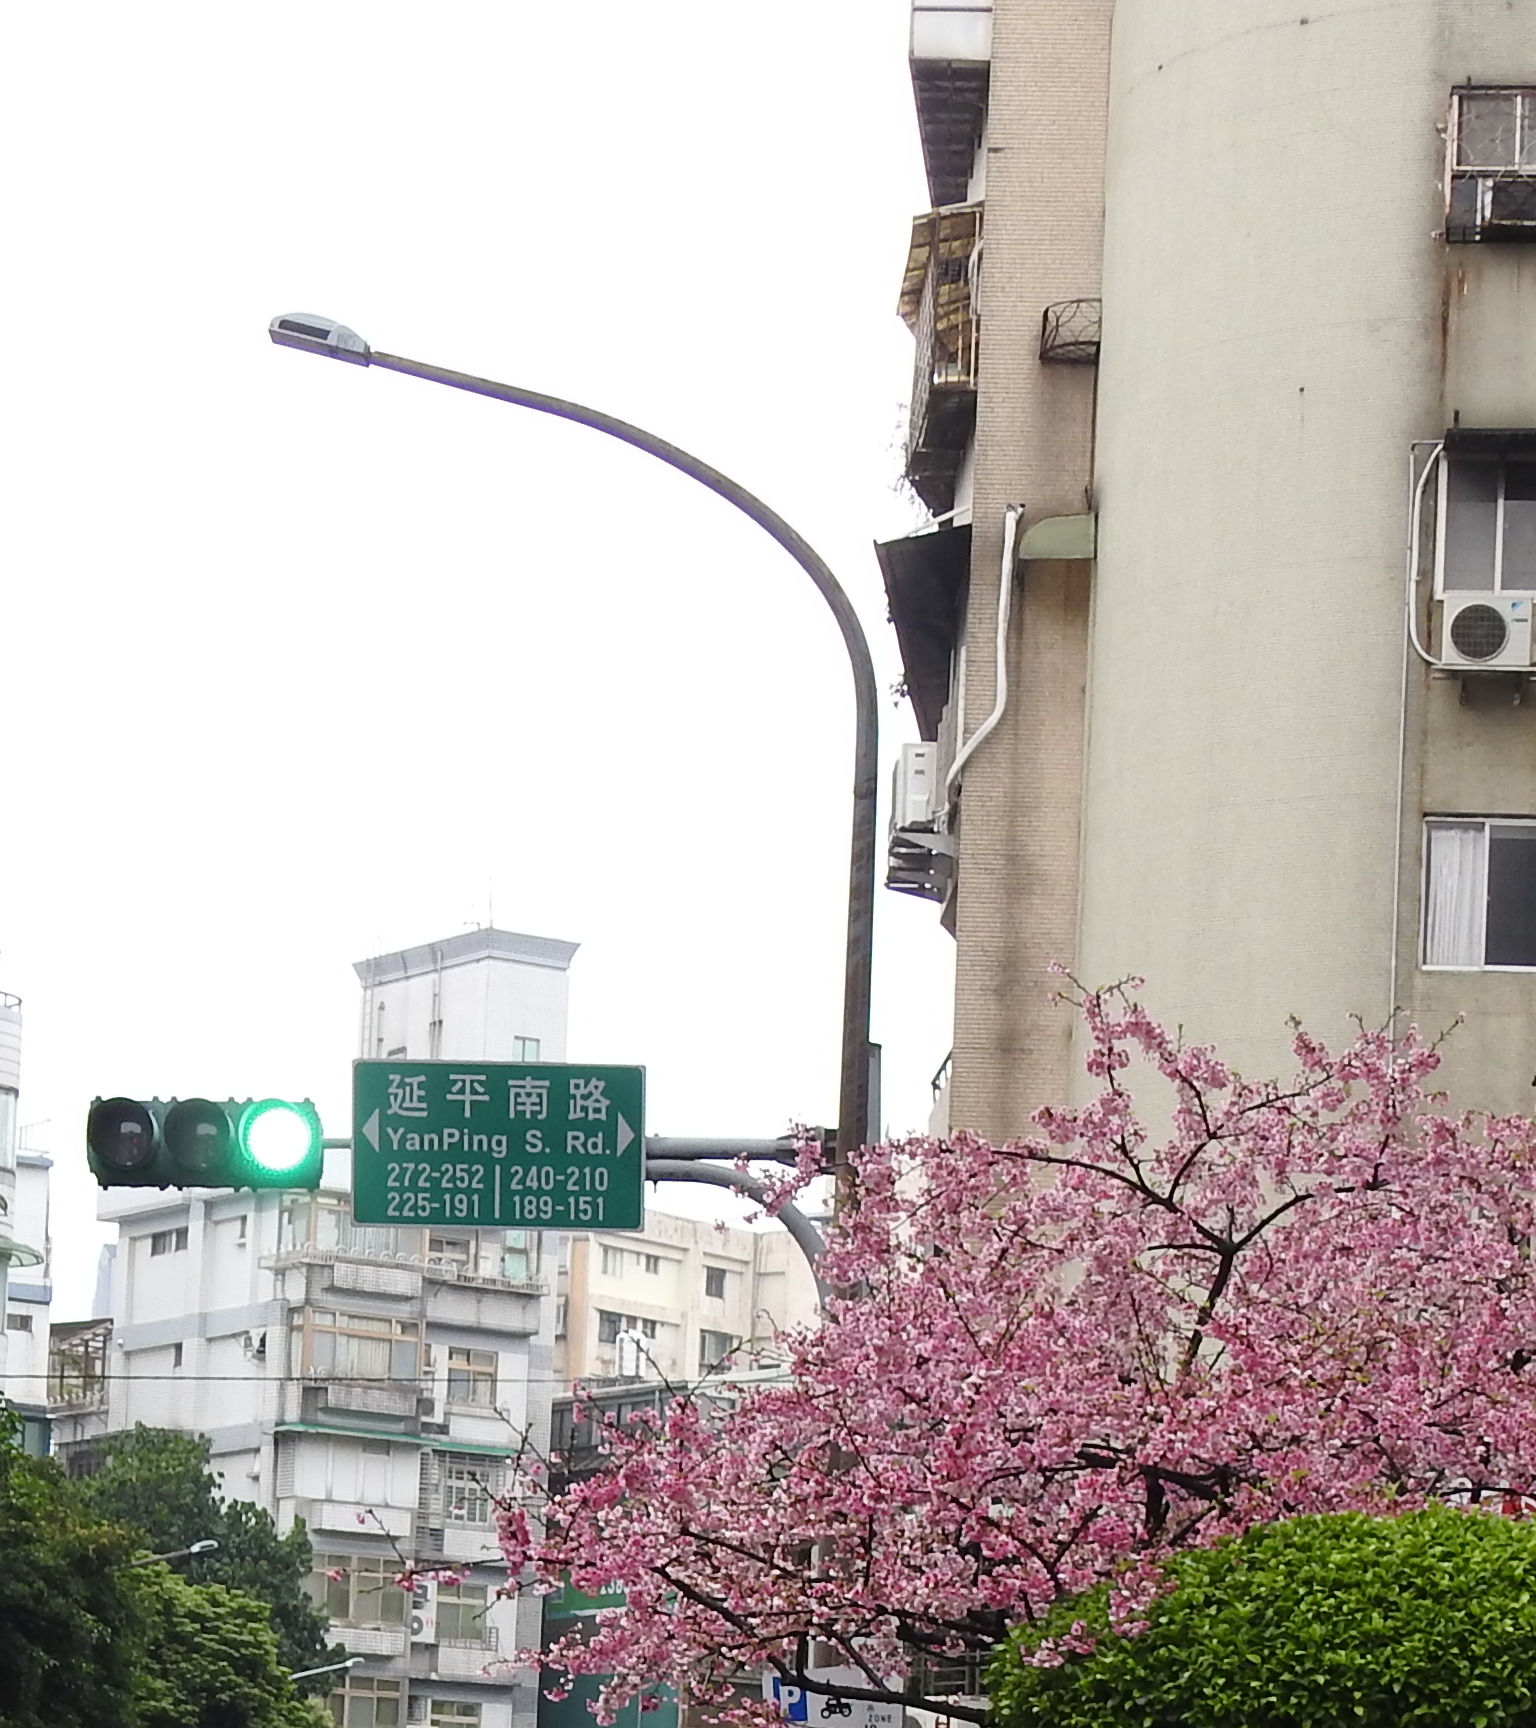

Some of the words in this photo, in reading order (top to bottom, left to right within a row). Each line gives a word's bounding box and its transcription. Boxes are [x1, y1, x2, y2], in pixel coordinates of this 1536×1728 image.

[386, 1074, 612, 1122] 延平南路
[386, 1127, 507, 1159] YanPing
[524, 1129, 551, 1154] S.
[566, 1131, 611, 1156] Rd.
[386, 1163, 485, 1189] 272-252
[509, 1166, 609, 1192] 240-210
[386, 1192, 479, 1218] 225-191
[513, 1196, 605, 1221] 189-151
